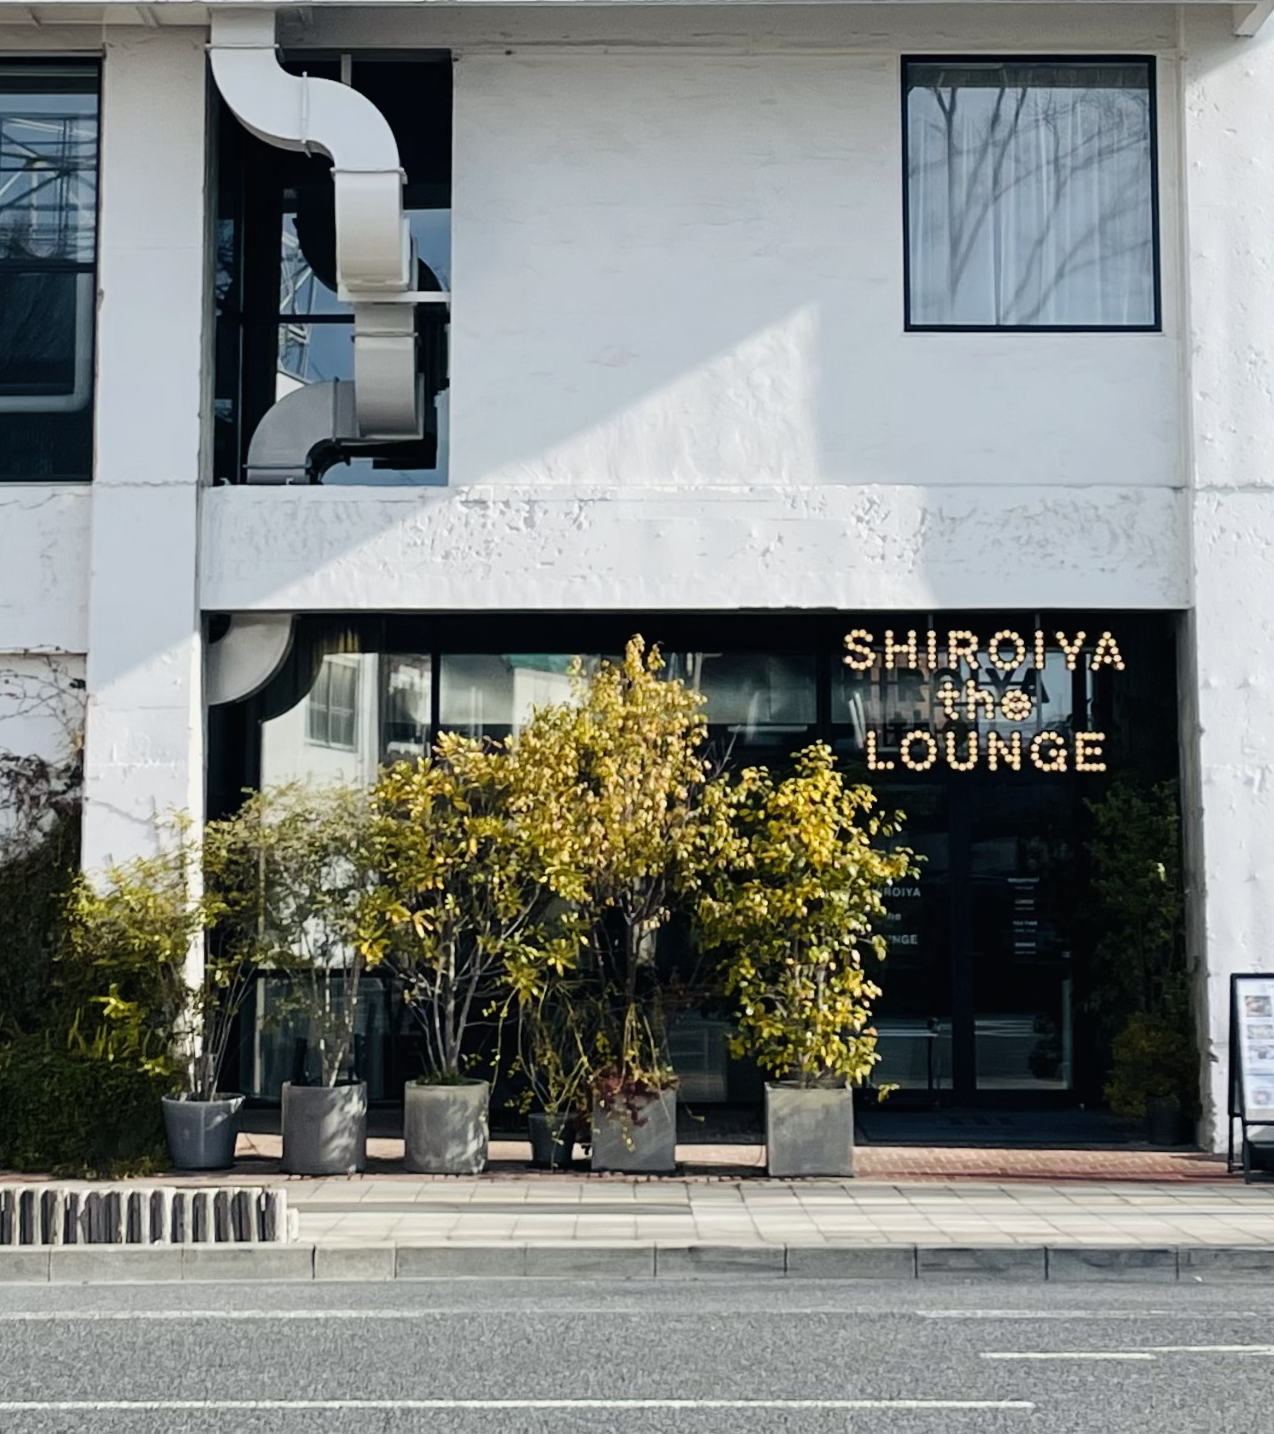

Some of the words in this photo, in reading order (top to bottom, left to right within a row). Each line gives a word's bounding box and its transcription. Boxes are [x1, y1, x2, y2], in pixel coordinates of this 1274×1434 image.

[843, 628, 1126, 671] SHIROIYA
[936, 678, 1033, 721] the
[865, 729, 1107, 772] LOUNGE
